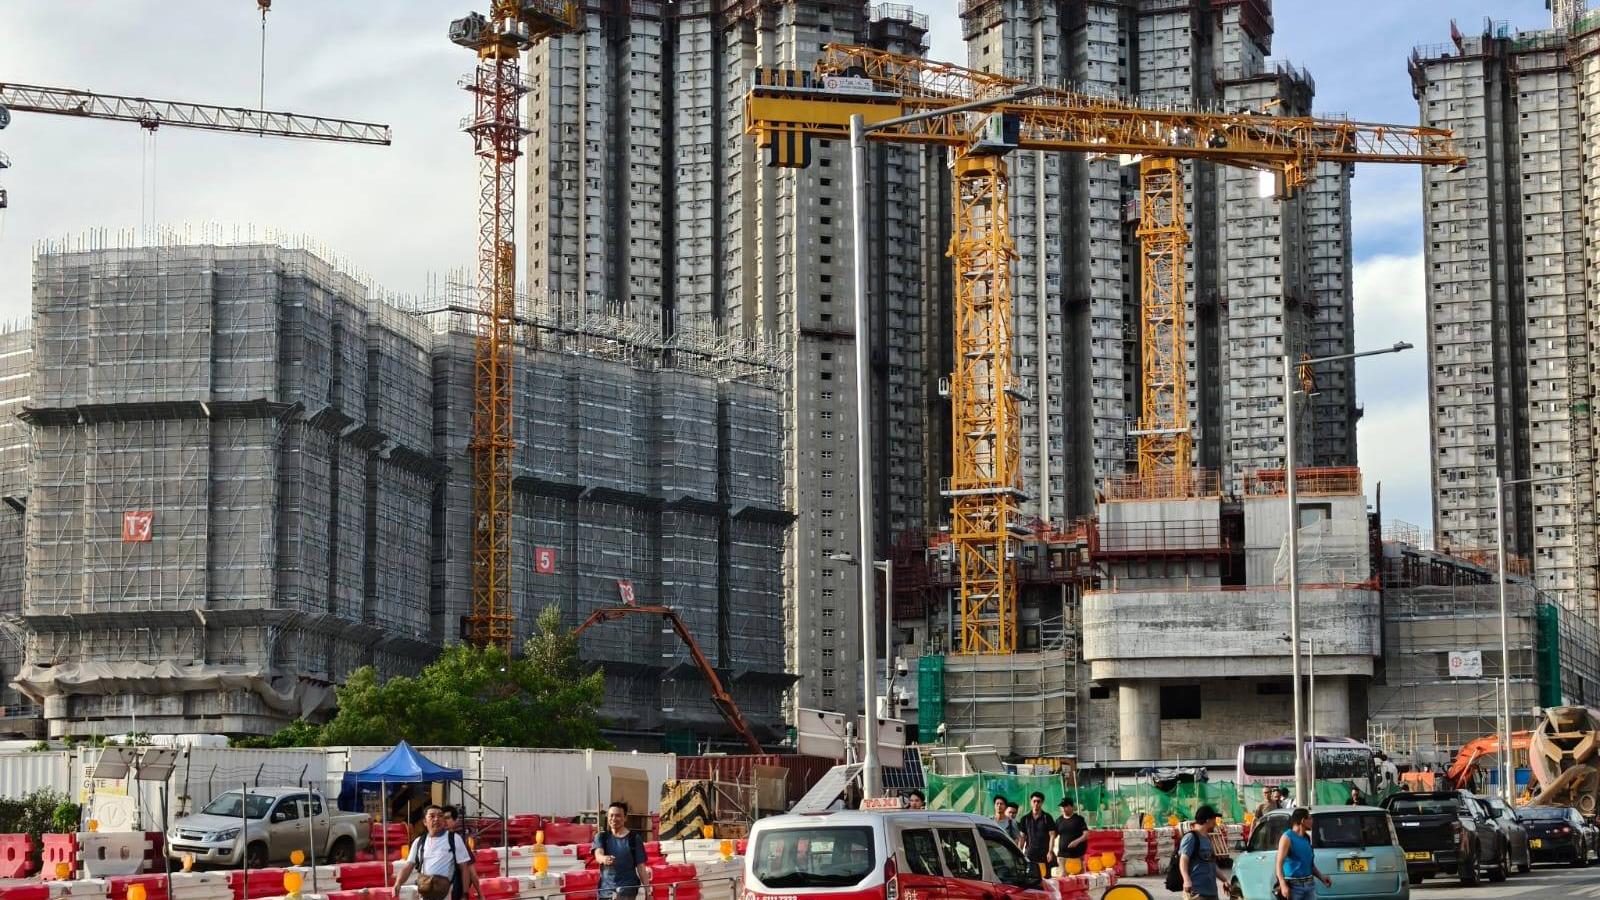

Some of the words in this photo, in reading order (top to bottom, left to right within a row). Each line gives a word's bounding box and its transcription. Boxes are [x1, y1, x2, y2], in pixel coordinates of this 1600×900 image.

[126, 515, 152, 541] T3
[541, 551, 550, 569] 5
[84, 780, 106, 788] GTE
[864, 799, 898, 808] TAXI
